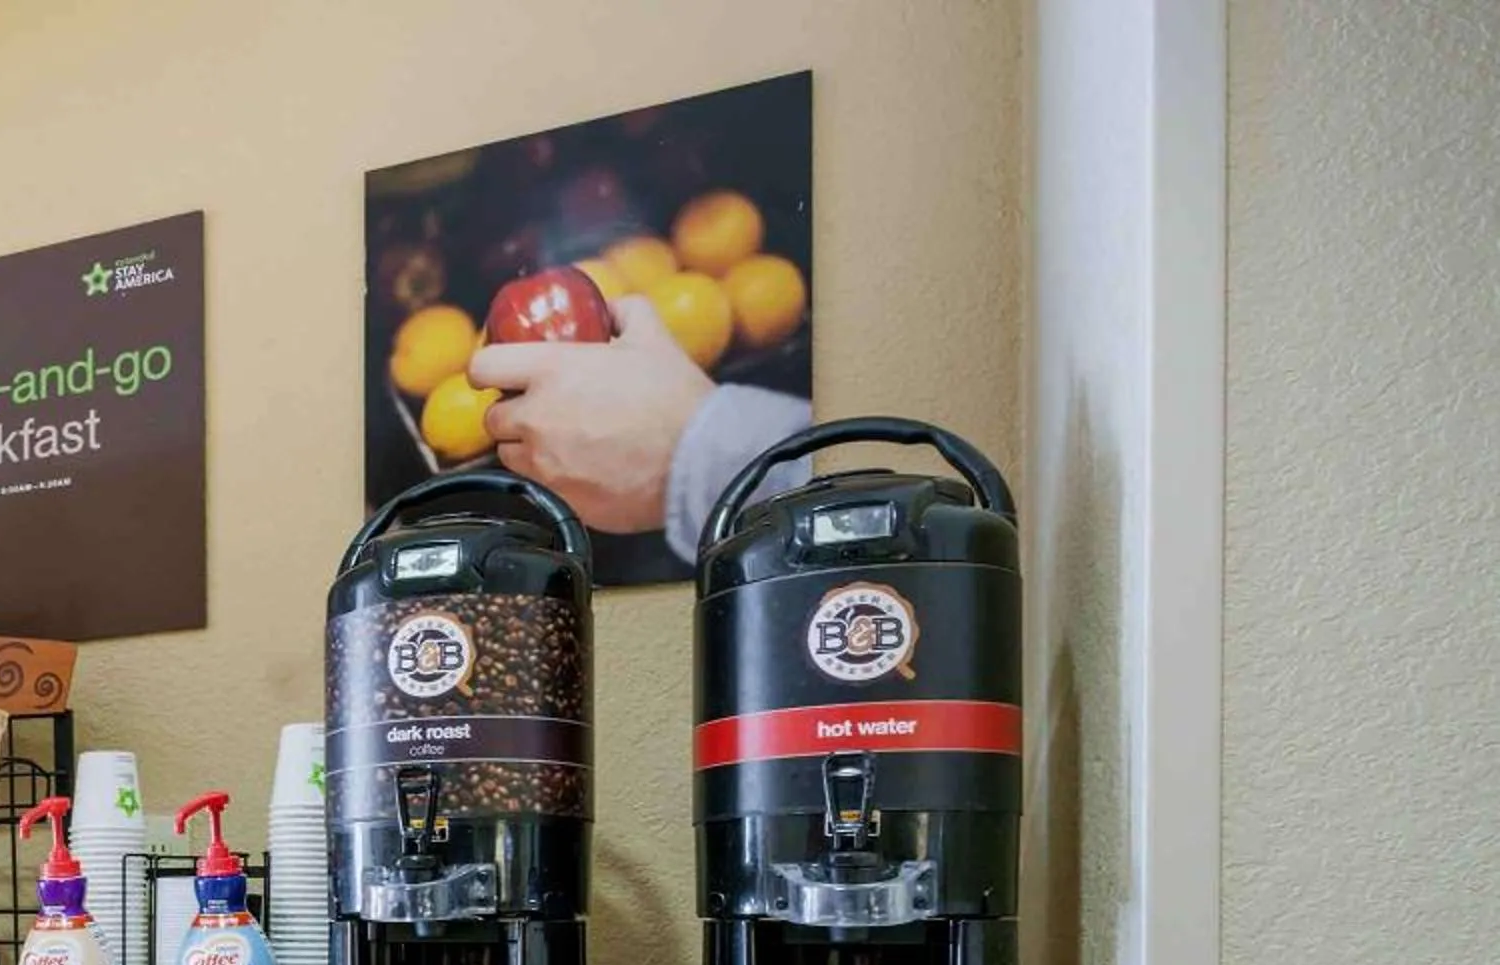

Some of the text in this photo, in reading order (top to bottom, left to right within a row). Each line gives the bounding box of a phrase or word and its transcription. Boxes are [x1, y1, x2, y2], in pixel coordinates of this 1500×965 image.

[114, 267, 175, 291] AMERICA
[115, 263, 146, 279] STAY
[815, 615, 905, 656] B&B
[394, 638, 465, 675] B&B
[386, 723, 472, 743] dark roast
[816, 717, 918, 739] hot water
[409, 743, 445, 757] coffee
